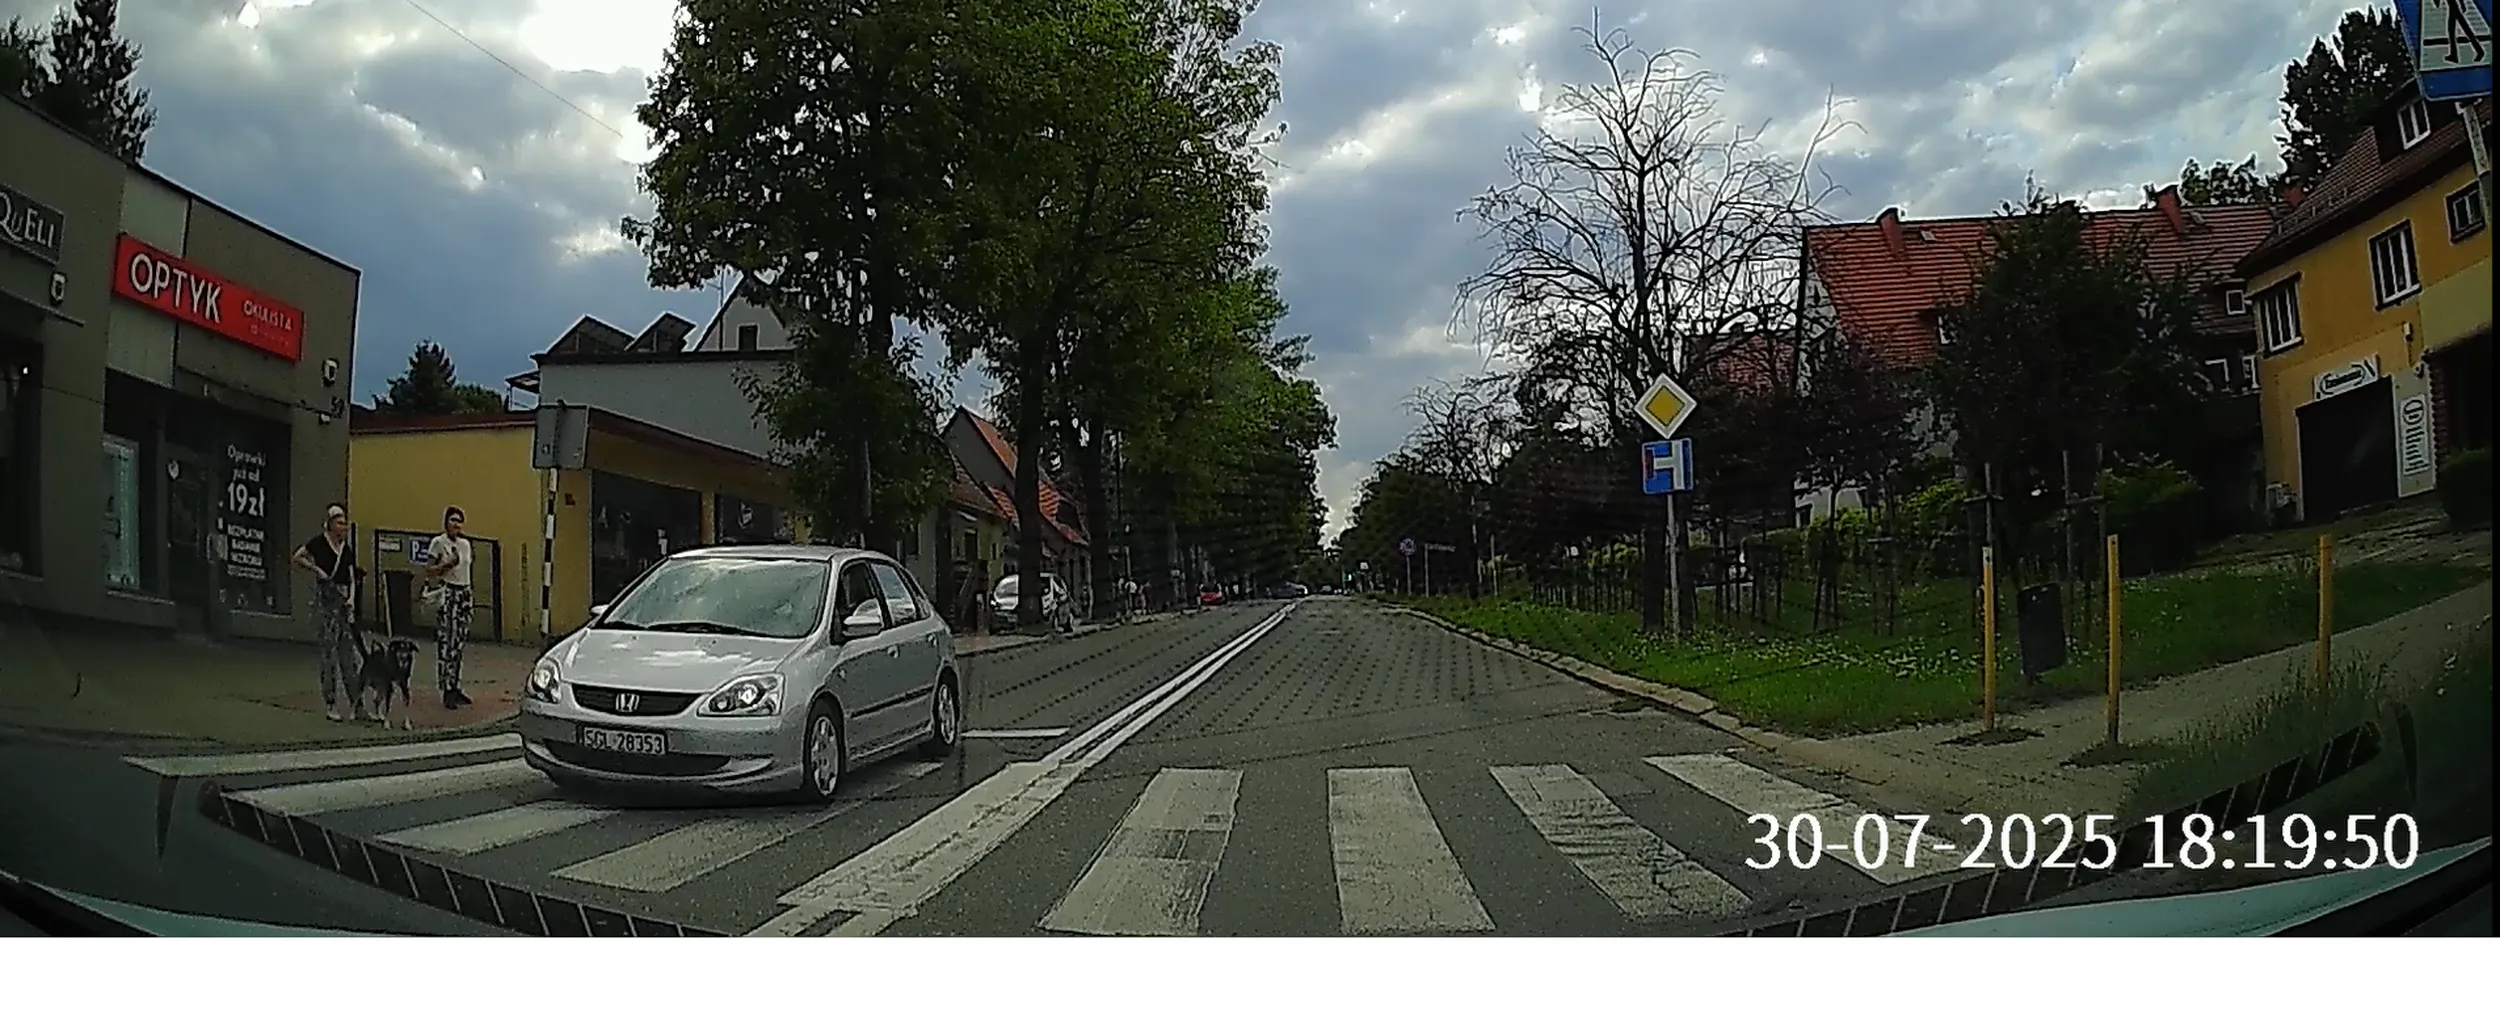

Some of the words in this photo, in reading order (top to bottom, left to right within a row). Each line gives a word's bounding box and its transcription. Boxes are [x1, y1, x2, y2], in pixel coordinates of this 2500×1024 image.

[130, 252, 222, 324] OPTYK
[585, 730, 612, 751] SGL
[617, 732, 663, 754] 28353
